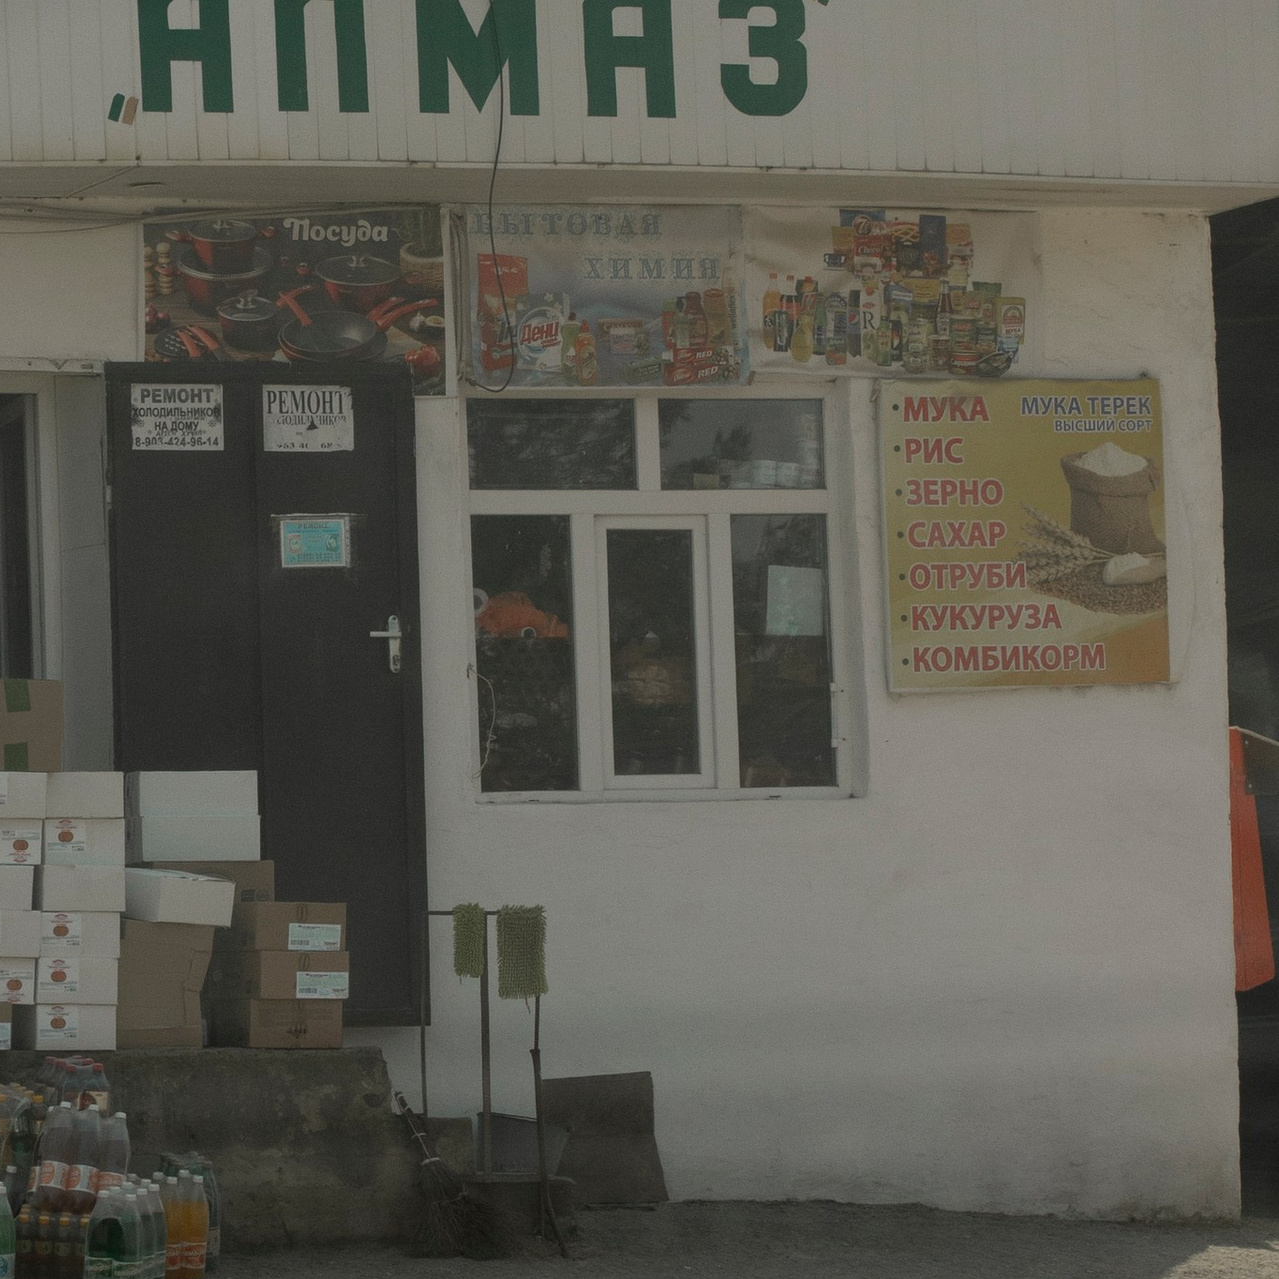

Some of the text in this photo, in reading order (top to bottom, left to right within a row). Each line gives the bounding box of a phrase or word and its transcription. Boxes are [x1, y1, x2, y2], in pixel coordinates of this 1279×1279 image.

[282, 217, 389, 247] Посуда
[582, 257, 721, 280] ХИМИЯ
[140, 388, 214, 404] РЕМОНТ
[266, 390, 345, 414] РЕМОНТ
[903, 395, 990, 422] МУКА
[1021, 396, 1152, 416] МУКА ТЕРЕК
[132, 407, 220, 418] ХОЛОДИЛЬНИКОВ
[1054, 417, 1153, 433] ВЫСШИЙ СОРТ
[154, 422, 199, 433] НА ДОМУ
[904, 437, 964, 464] РИС
[905, 479, 1004, 506] ЗЕРНО
[907, 520, 1006, 548] САХАР
[909, 562, 1027, 590] ОТРУБИ
[911, 603, 1062, 631] КУКУРУЗА
[912, 643, 1106, 672] КОМБИКОРМ
